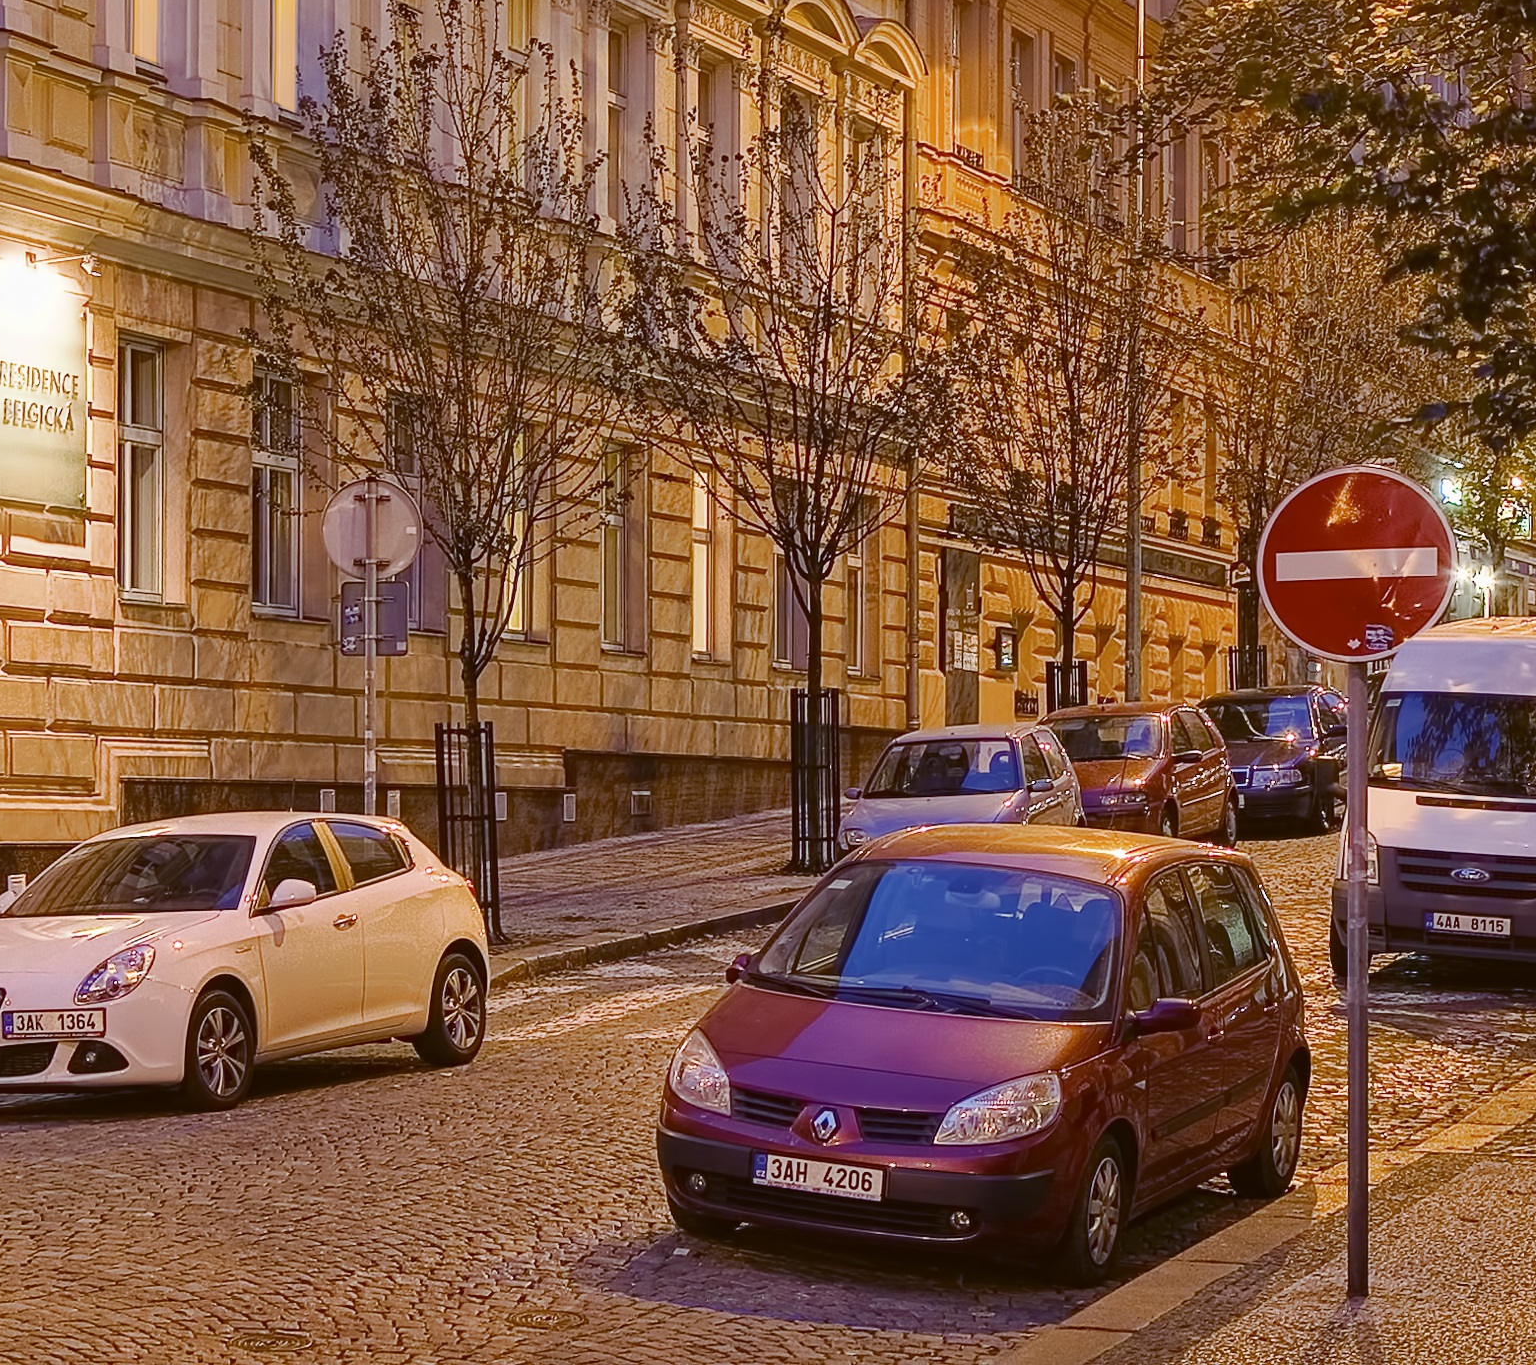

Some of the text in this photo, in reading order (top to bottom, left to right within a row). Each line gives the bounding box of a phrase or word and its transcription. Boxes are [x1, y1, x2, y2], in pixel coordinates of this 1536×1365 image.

[3, 401, 74, 432] BELGICKÁ
[1436, 915, 1504, 933] 4AA 8115
[16, 1014, 44, 1031] 3AK
[57, 1013, 96, 1031] 1364
[771, 1158, 808, 1183] 3AH
[822, 1166, 873, 1192] 4206
